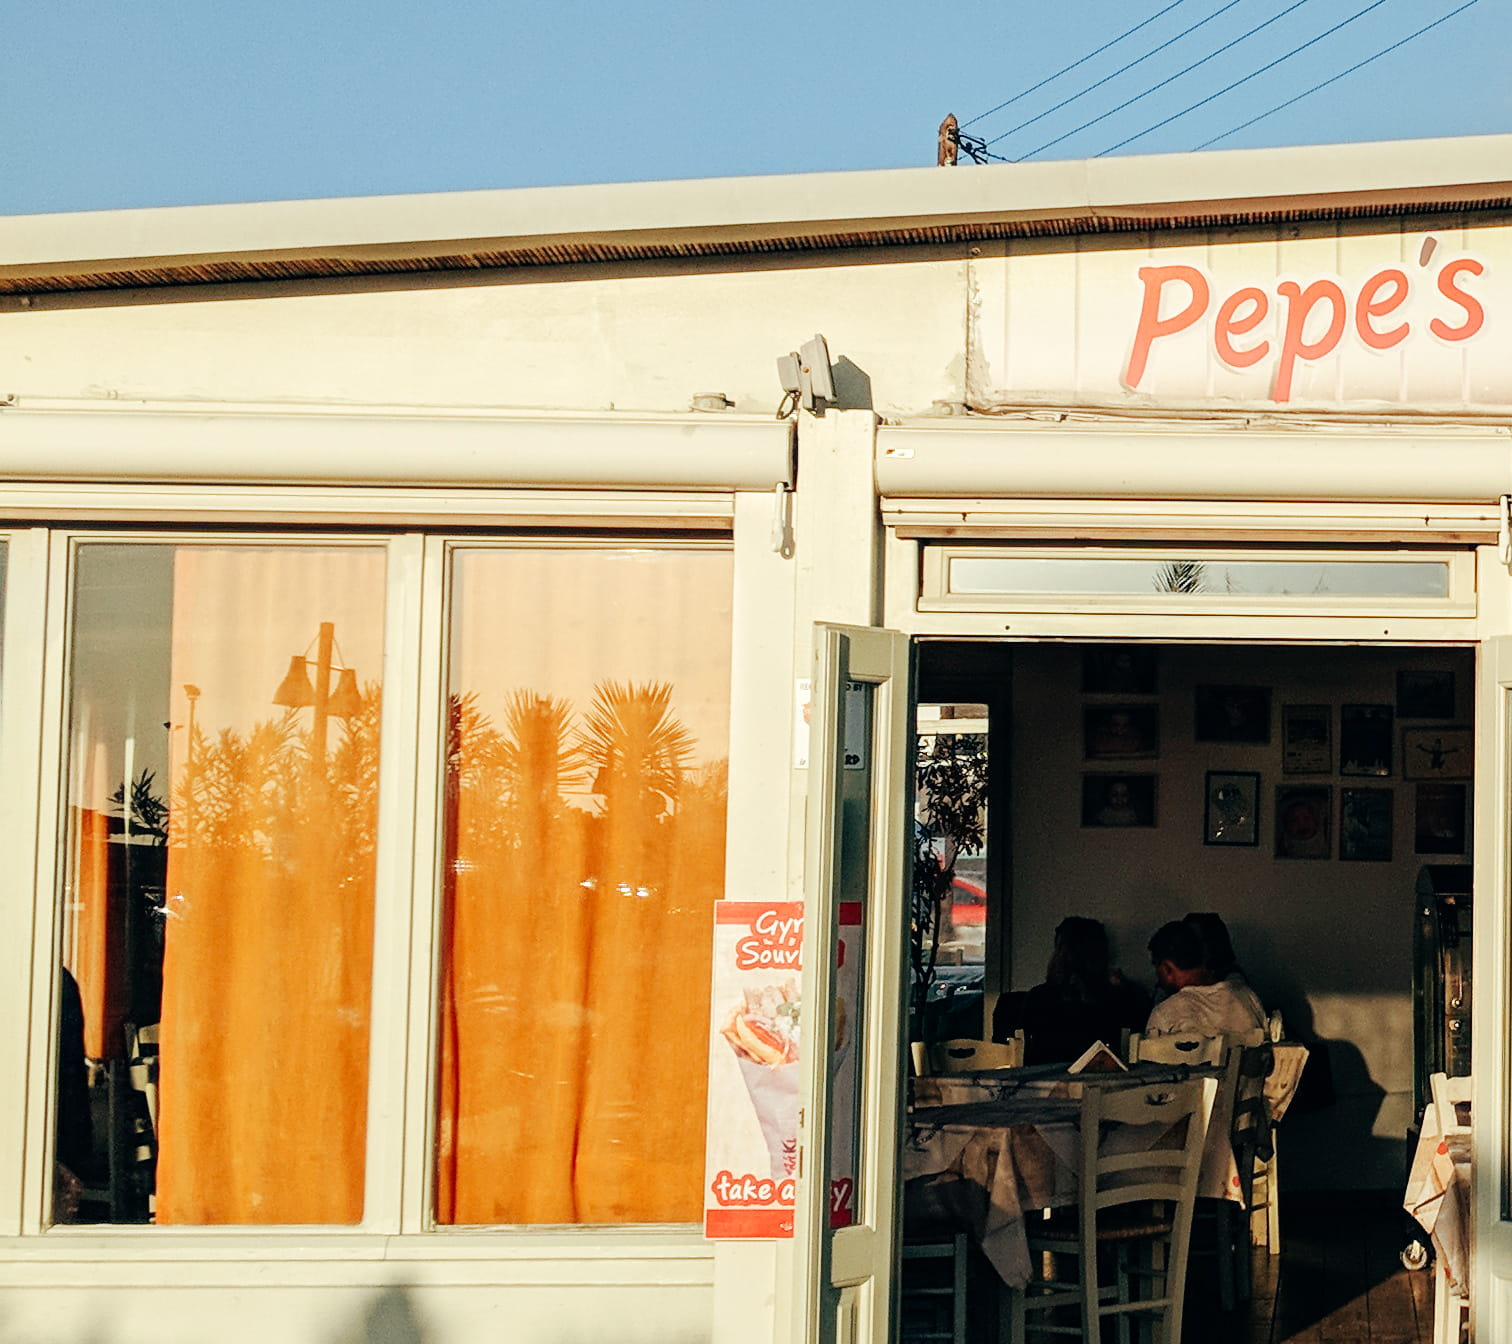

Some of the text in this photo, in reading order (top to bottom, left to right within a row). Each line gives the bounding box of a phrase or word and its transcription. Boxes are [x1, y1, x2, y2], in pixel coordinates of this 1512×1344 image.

[1123, 237, 1485, 402] Pepe's
[755, 910, 805, 944] Gyr
[717, 1175, 772, 1200] take
